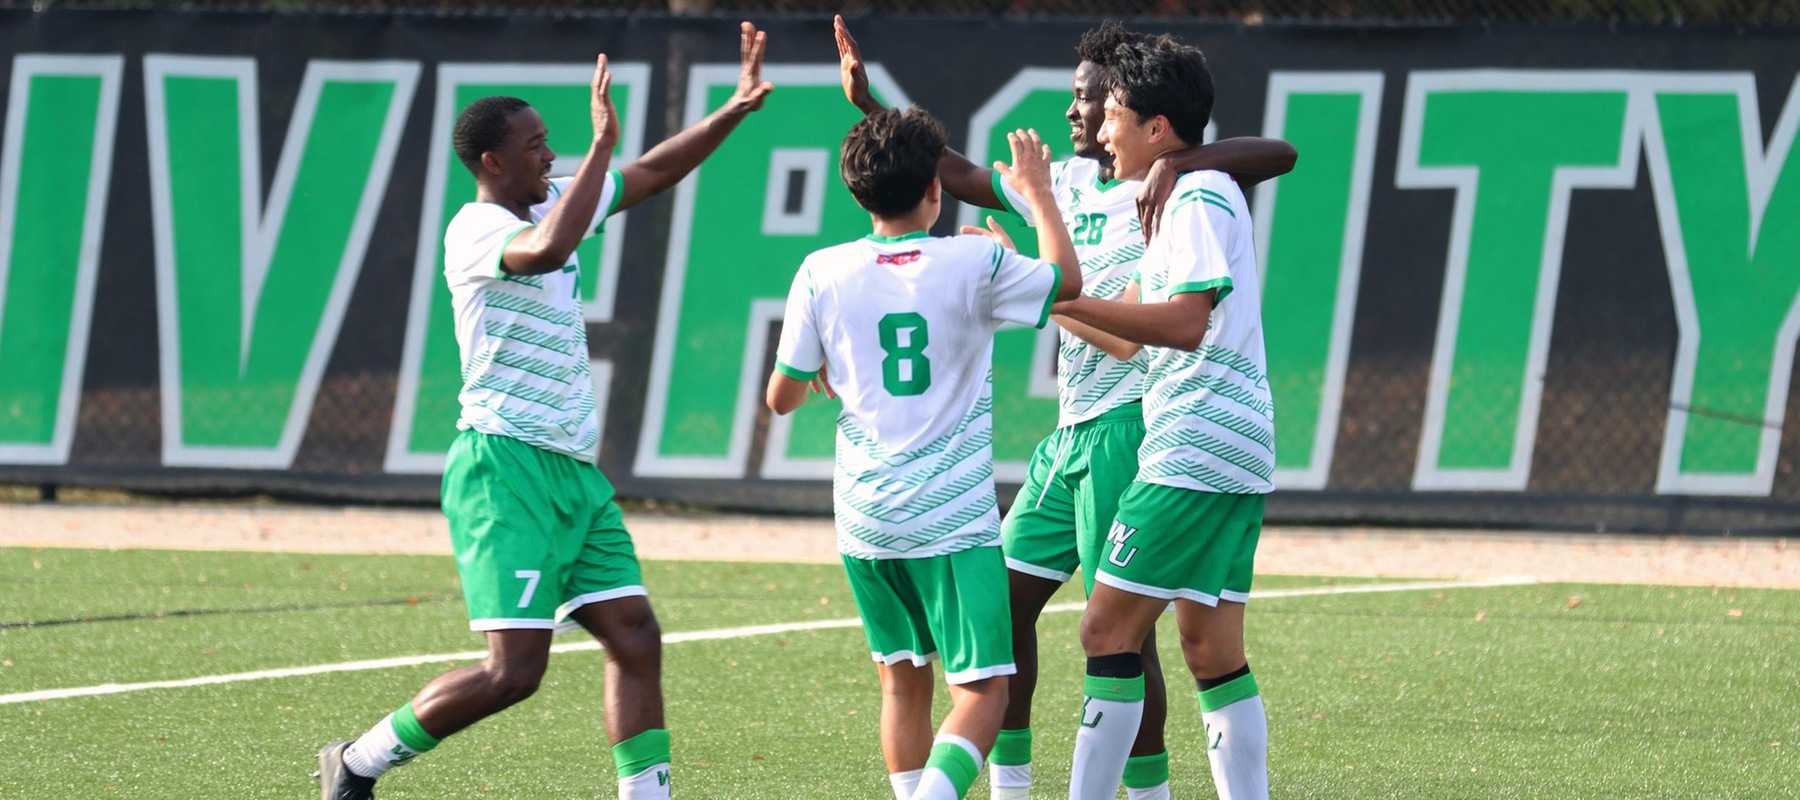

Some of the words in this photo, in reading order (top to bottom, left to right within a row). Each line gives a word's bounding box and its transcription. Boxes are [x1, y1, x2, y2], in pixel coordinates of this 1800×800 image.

[1073, 212, 1107, 246] 28
[878, 312, 931, 397] 8
[514, 569, 541, 608] 7
